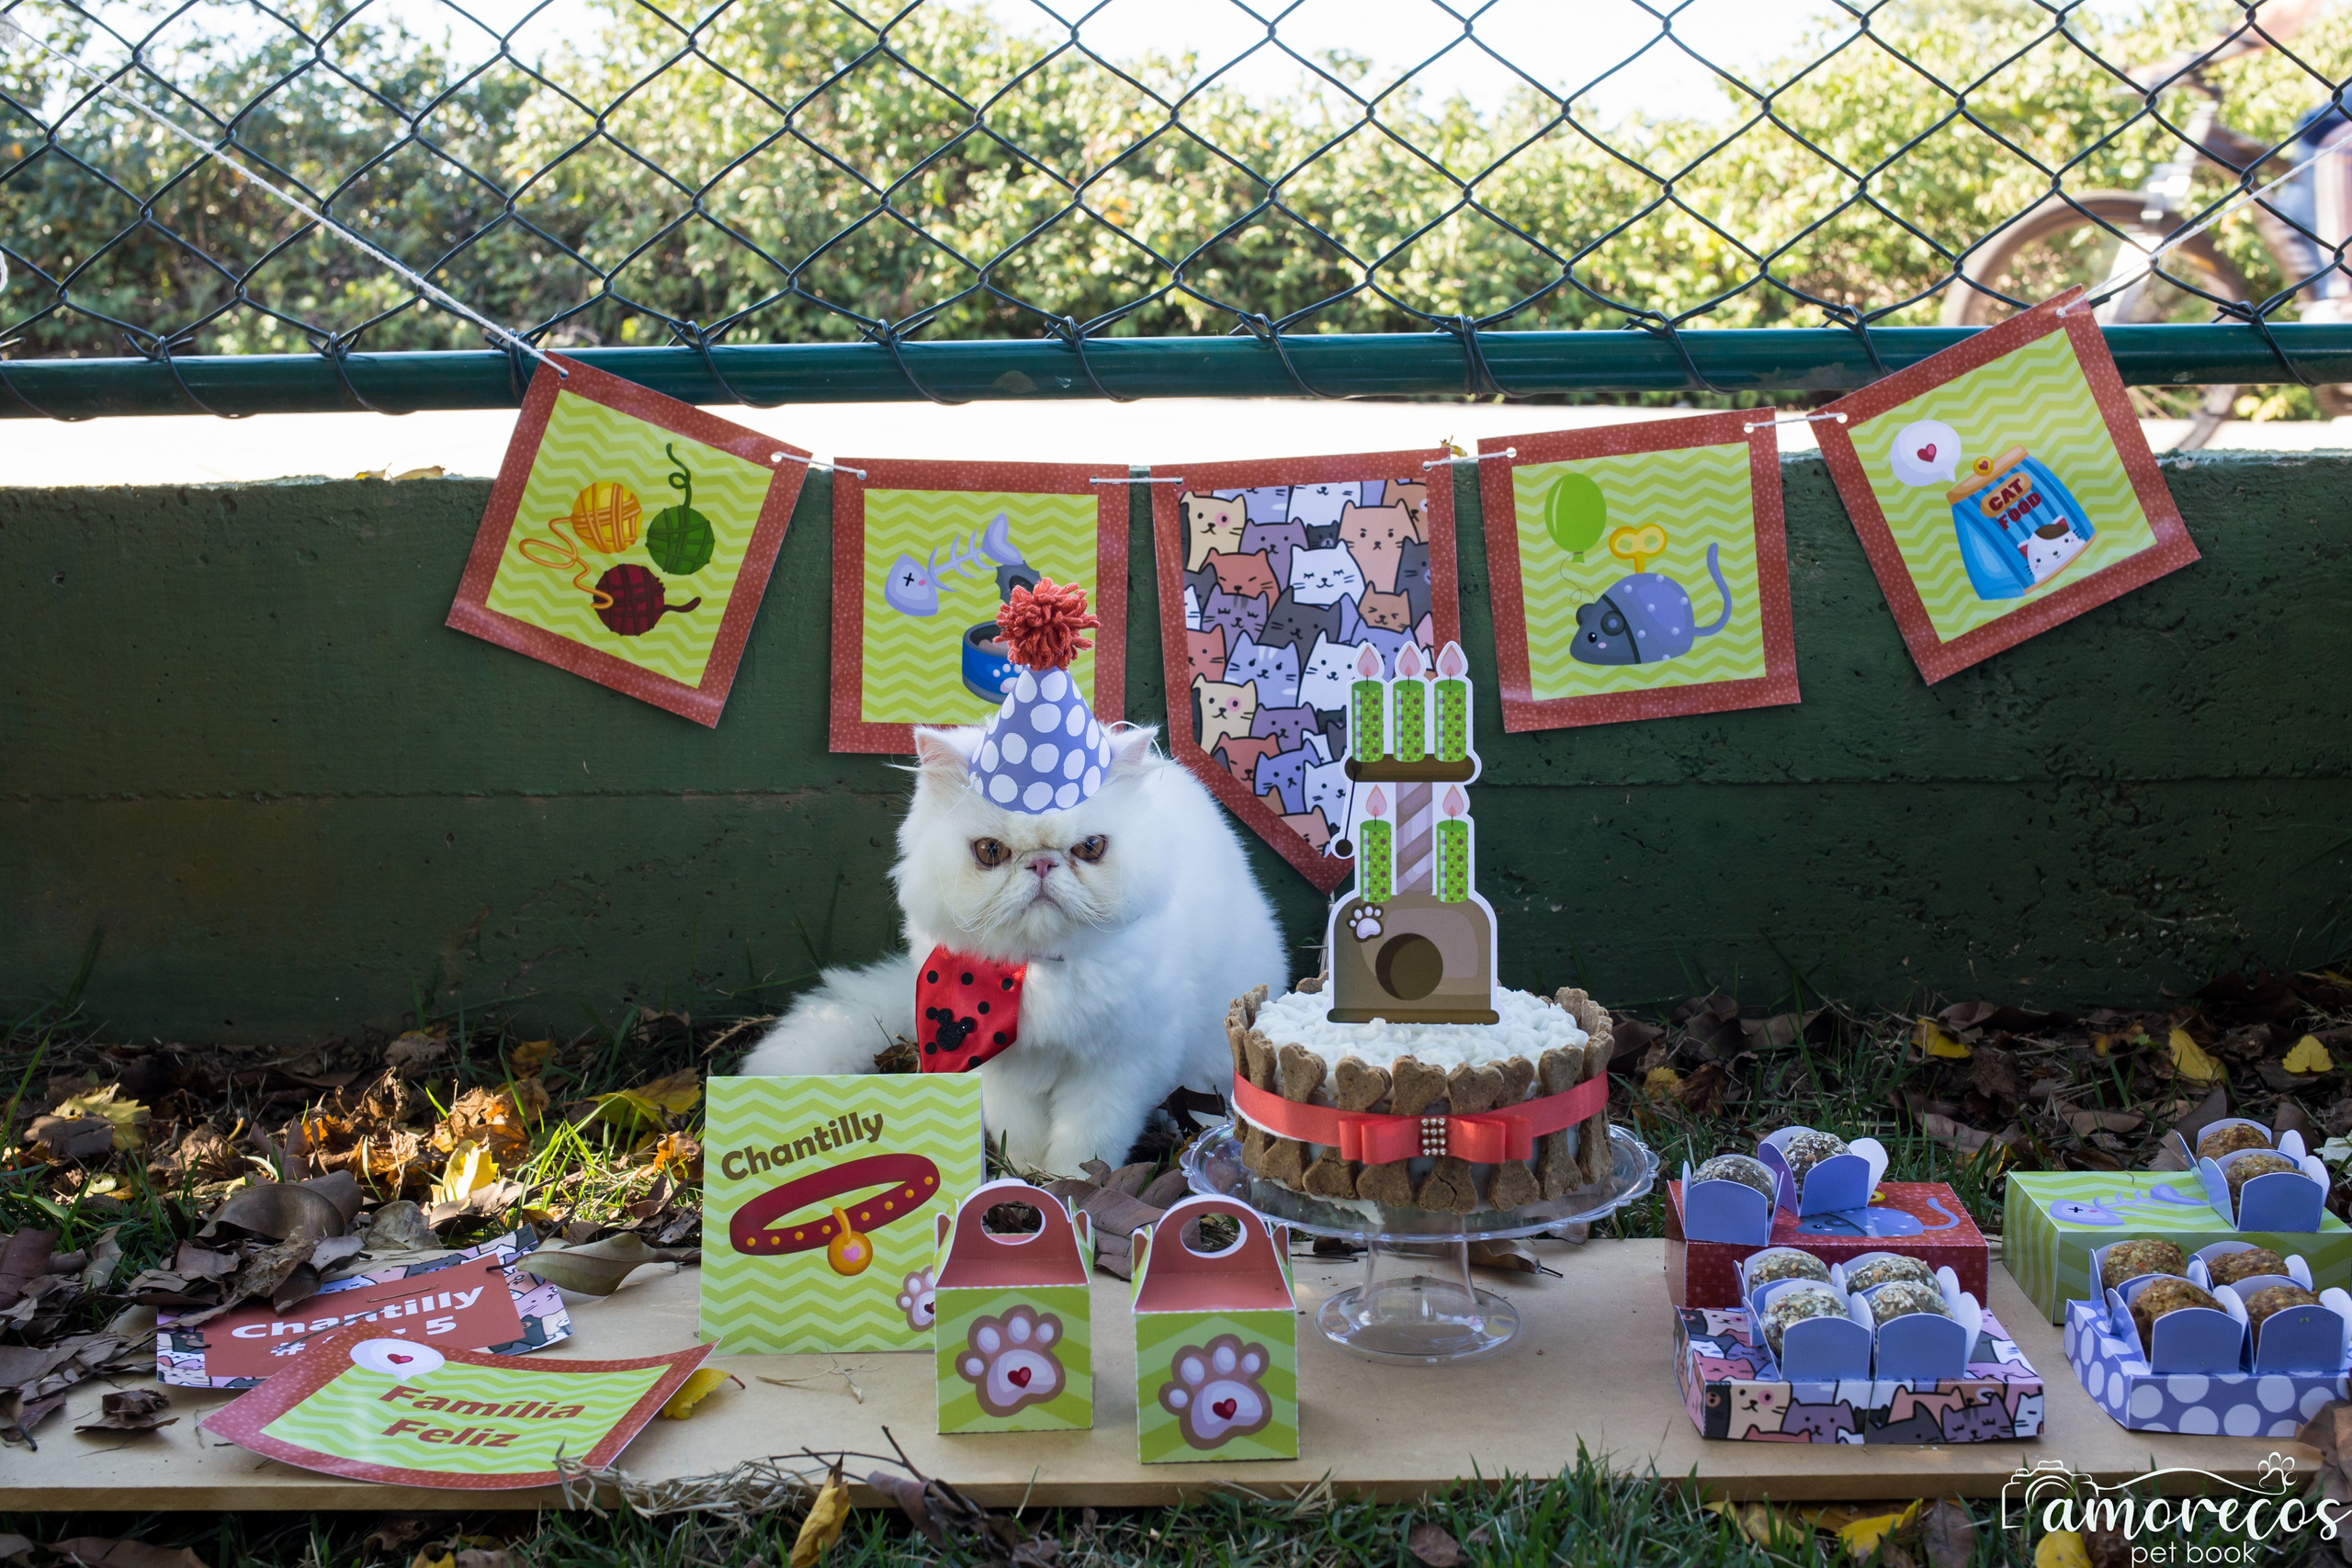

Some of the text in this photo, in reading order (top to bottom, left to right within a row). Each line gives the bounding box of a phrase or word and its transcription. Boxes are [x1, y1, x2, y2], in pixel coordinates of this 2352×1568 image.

[1988, 477, 2024, 512] CAT
[1996, 491, 2042, 531] FOOD
[721, 1111, 884, 1180] Chantilly
[232, 1286, 485, 1338] Chantilly
[381, 1418, 521, 1448] Feliz
